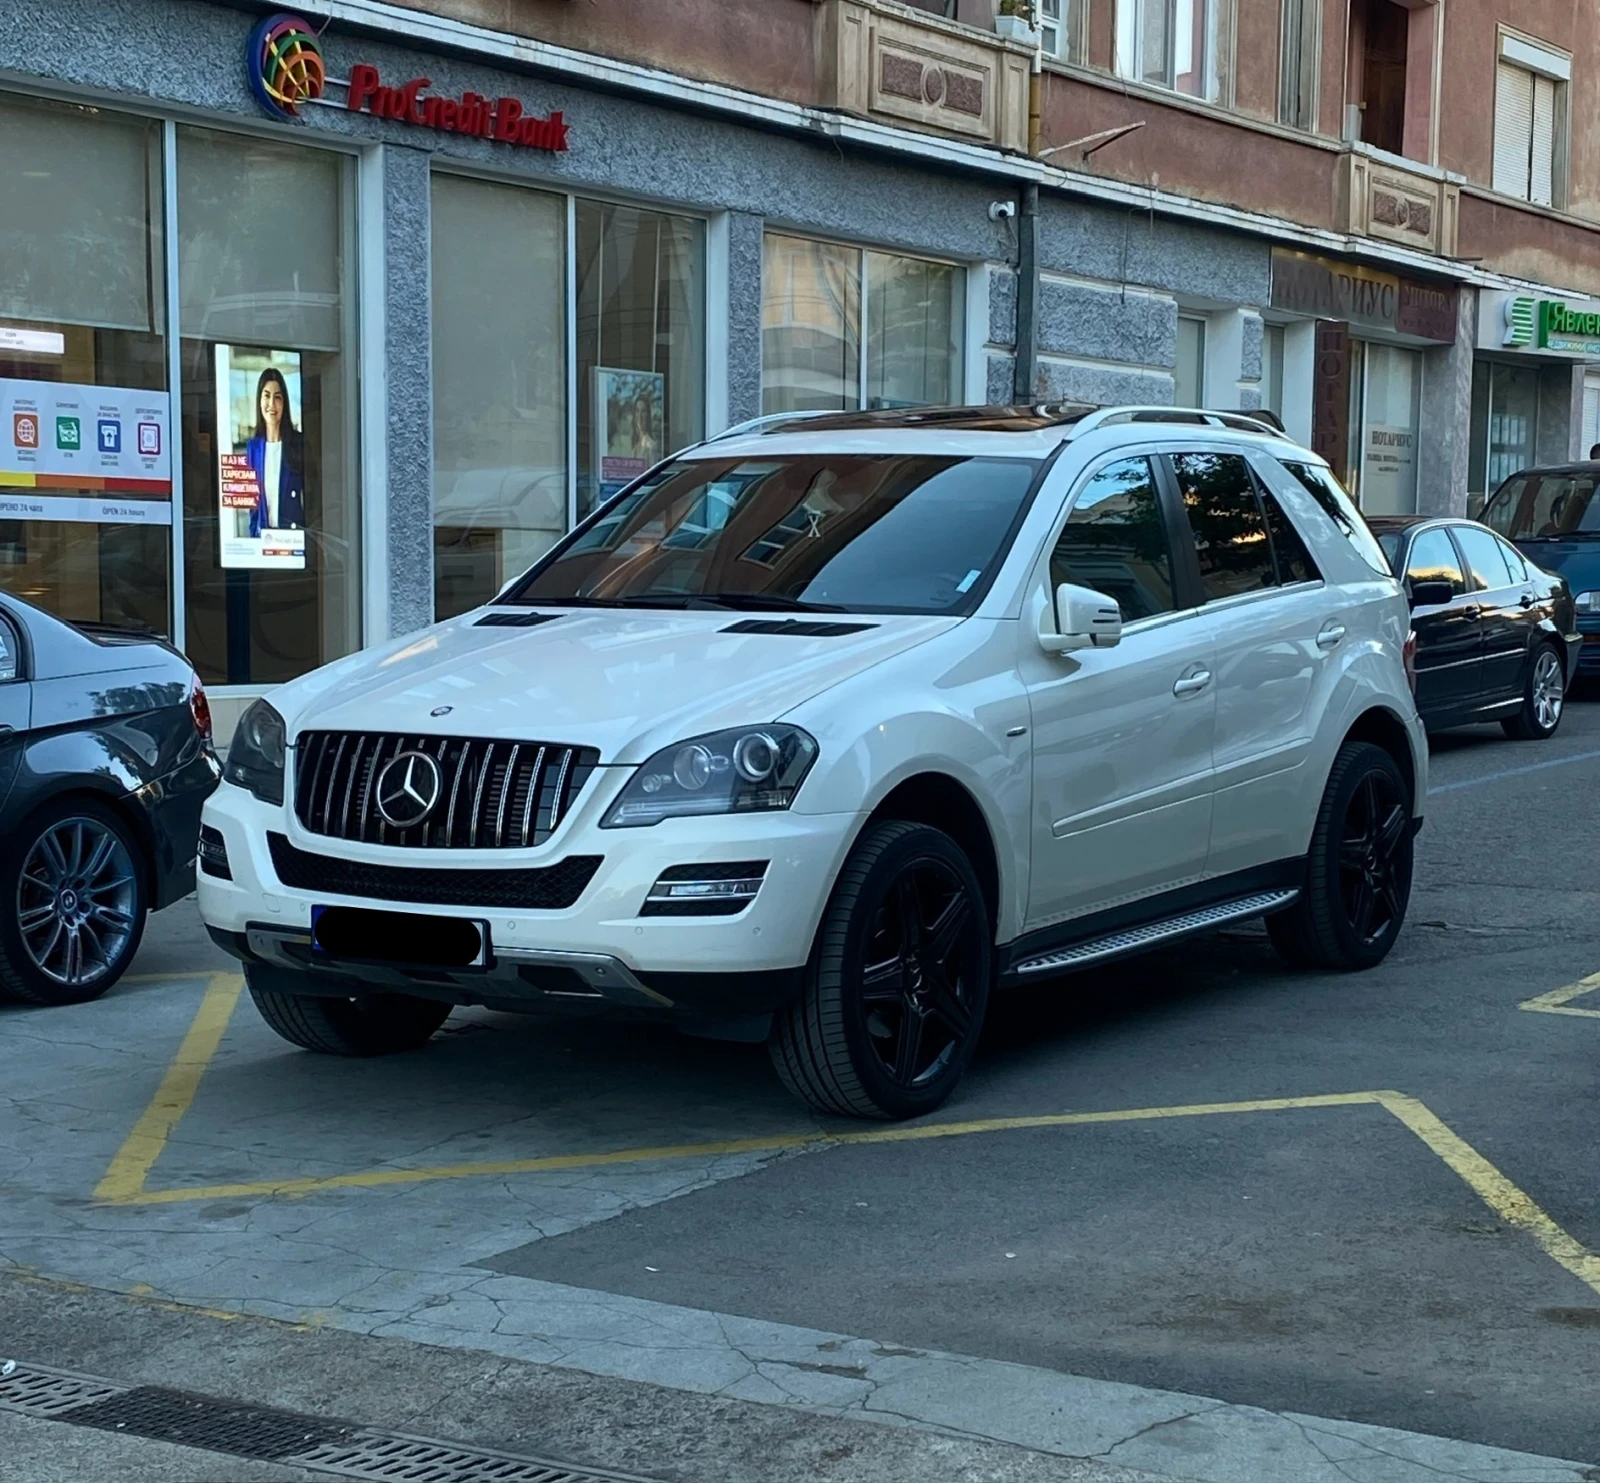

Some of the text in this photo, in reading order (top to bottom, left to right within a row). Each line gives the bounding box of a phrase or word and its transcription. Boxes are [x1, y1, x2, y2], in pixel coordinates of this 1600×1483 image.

[347, 63, 569, 151] ProCredit Bank
[1371, 430, 1412, 448] НОТАРИУС
[102, 508, 145, 517] OPEN 24 hours
